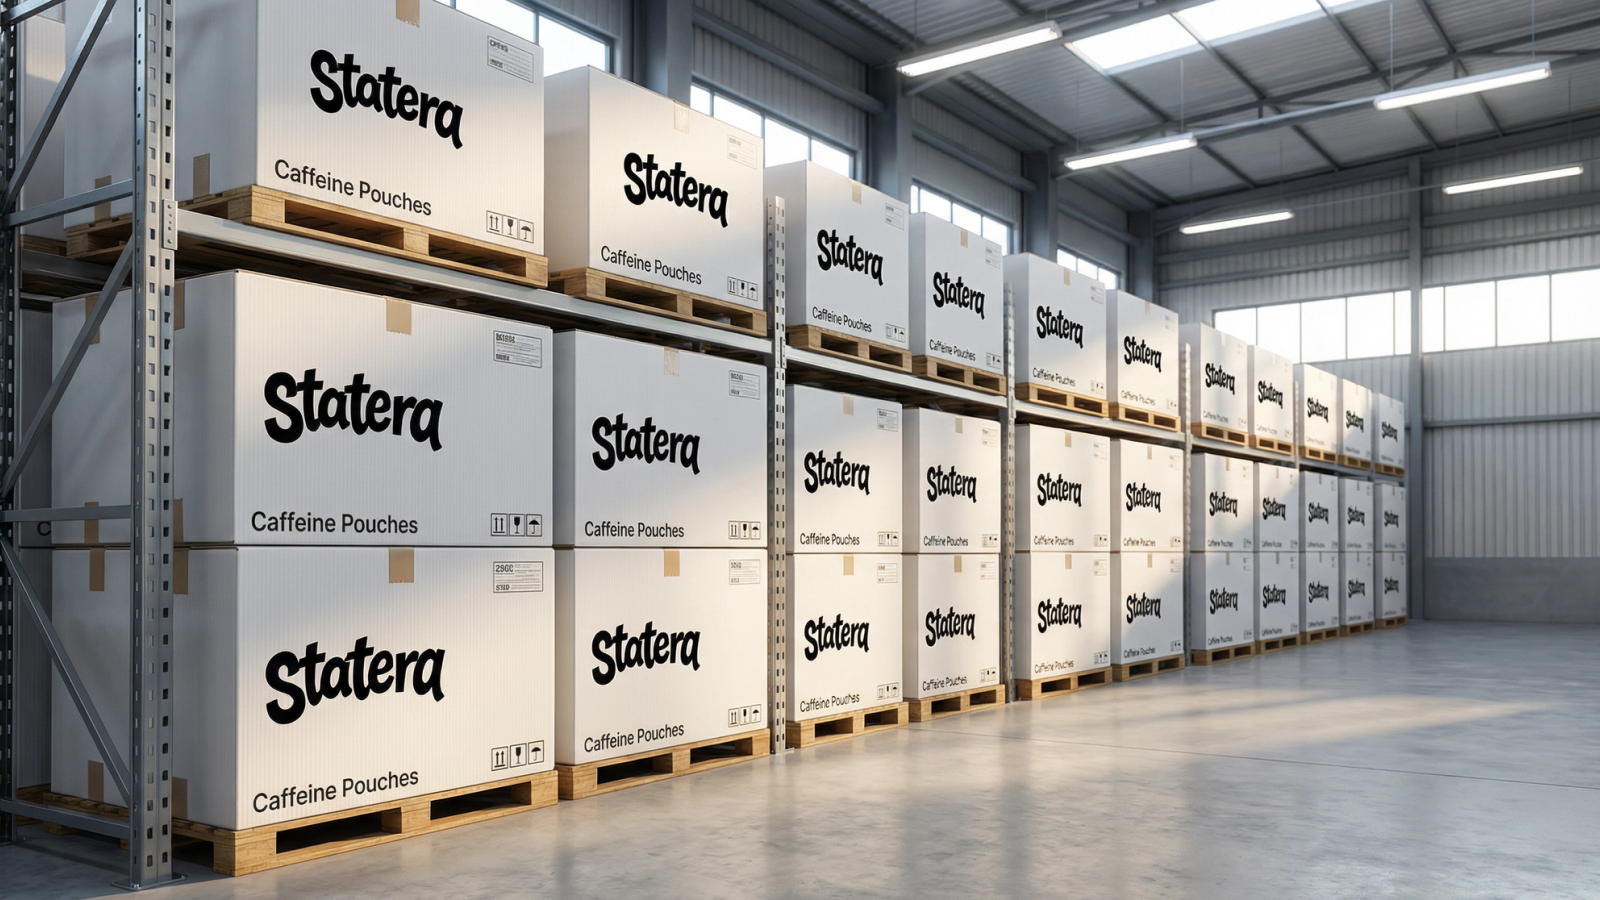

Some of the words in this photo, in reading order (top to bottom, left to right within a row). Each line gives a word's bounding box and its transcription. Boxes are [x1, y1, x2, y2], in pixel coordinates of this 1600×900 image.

[310, 50, 463, 149] Statera
[274, 159, 354, 196] Caffeine
[359, 180, 432, 216] Pouches
[624, 153, 728, 228] Statera
[601, 246, 651, 274] Caffeine
[654, 259, 702, 285] Pouches
[817, 230, 883, 286] Statera
[933, 272, 985, 319] Statera
[812, 307, 842, 326] Caffeine
[844, 317, 872, 333] Pouches
[1037, 306, 1083, 348] Statera
[1124, 336, 1161, 372] Statera
[1206, 363, 1235, 395] Statera
[1258, 381, 1283, 409] Statera
[264, 369, 443, 451] Statera
[592, 413, 700, 475] Statera
[804, 450, 870, 495] Statera
[927, 465, 976, 503] Statera
[1037, 473, 1081, 507] Statera
[1126, 482, 1161, 512] Statera
[1210, 491, 1237, 517] Statera
[1263, 498, 1286, 520] Statera
[252, 511, 336, 532] Caffeine
[342, 514, 418, 534] Pouches
[585, 521, 634, 537] Caffeine
[638, 523, 684, 537] Pouches
[800, 533, 830, 545] Caffeine
[832, 534, 860, 545] Pouches
[1127, 593, 1161, 624] Statera
[1210, 588, 1238, 614] Statera
[1263, 585, 1286, 608] Statera
[926, 607, 975, 646] Statera
[1038, 598, 1081, 633] Statera
[592, 621, 700, 685] Statera
[804, 614, 869, 661] Statera
[266, 636, 445, 724] Statera
[800, 696, 830, 712] Caffeine
[832, 693, 860, 707] Pouches
[585, 731, 634, 752] Caffeine
[638, 724, 684, 742] Pouches
[253, 779, 337, 813] Caffeine
[342, 770, 419, 796] Pouches
